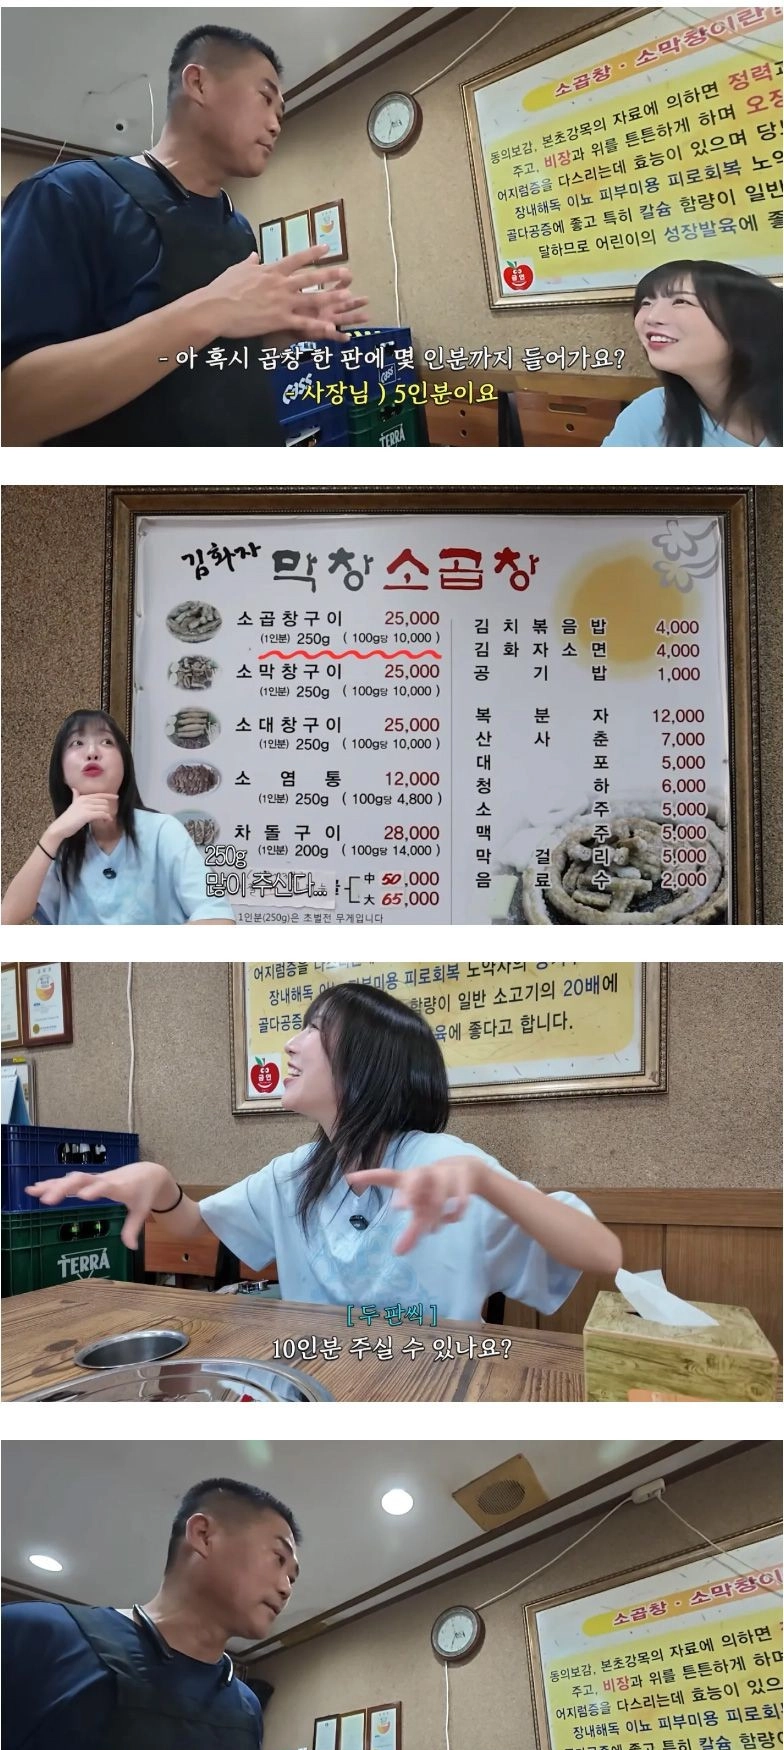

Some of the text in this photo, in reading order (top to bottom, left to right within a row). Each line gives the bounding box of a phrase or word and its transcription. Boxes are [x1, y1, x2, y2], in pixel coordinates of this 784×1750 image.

[490, 81, 719, 165] 동의보감, 본초강목의 자료에 의하면
[544, 146, 584, 169] 비장과
[591, 137, 617, 160] 위를
[625, 116, 690, 147] 튼튼하게
[698, 104, 736, 127] 하며
[497, 129, 748, 202] 어지럼증을 다스리는데 효능이 있으며
[514, 159, 741, 219] 장내해독 이뇨 피부미용 피로회복
[507, 189, 735, 242] 골다공증에 좋고 특히 칼슘 함량이
[538, 215, 758, 259] 달하므로 어린이의 성장발육에
[181, 542, 261, 580] 김화자
[385, 611, 439, 628] 25,000
[655, 620, 700, 636] 4,000
[260, 633, 291, 645] (1인분)
[297, 633, 330, 646] 250g
[656, 643, 700, 660] 4,000
[384, 664, 439, 681] 25,000
[657, 667, 700, 683] 1,000
[259, 686, 290, 698] (1인분)
[296, 686, 330, 699] 250g
[385, 771, 440, 788] 12,000
[258, 793, 289, 805] (1인분)
[295, 793, 329, 807] 250g
[238, 913, 383, 924] 1인분(250g)은 초벌전 무게입니다
[404, 967, 461, 987] 피로회복
[269, 972, 619, 1010] 장내해독 일반 소고기의 20배에
[467, 1011, 573, 1039] 좋다고 합니다.
[58, 1248, 111, 1277] TERRA
[613, 1601, 667, 1626] 소곱창
[617, 1690, 684, 1712] 다스리는데
[659, 1711, 719, 1730] 피부미용
